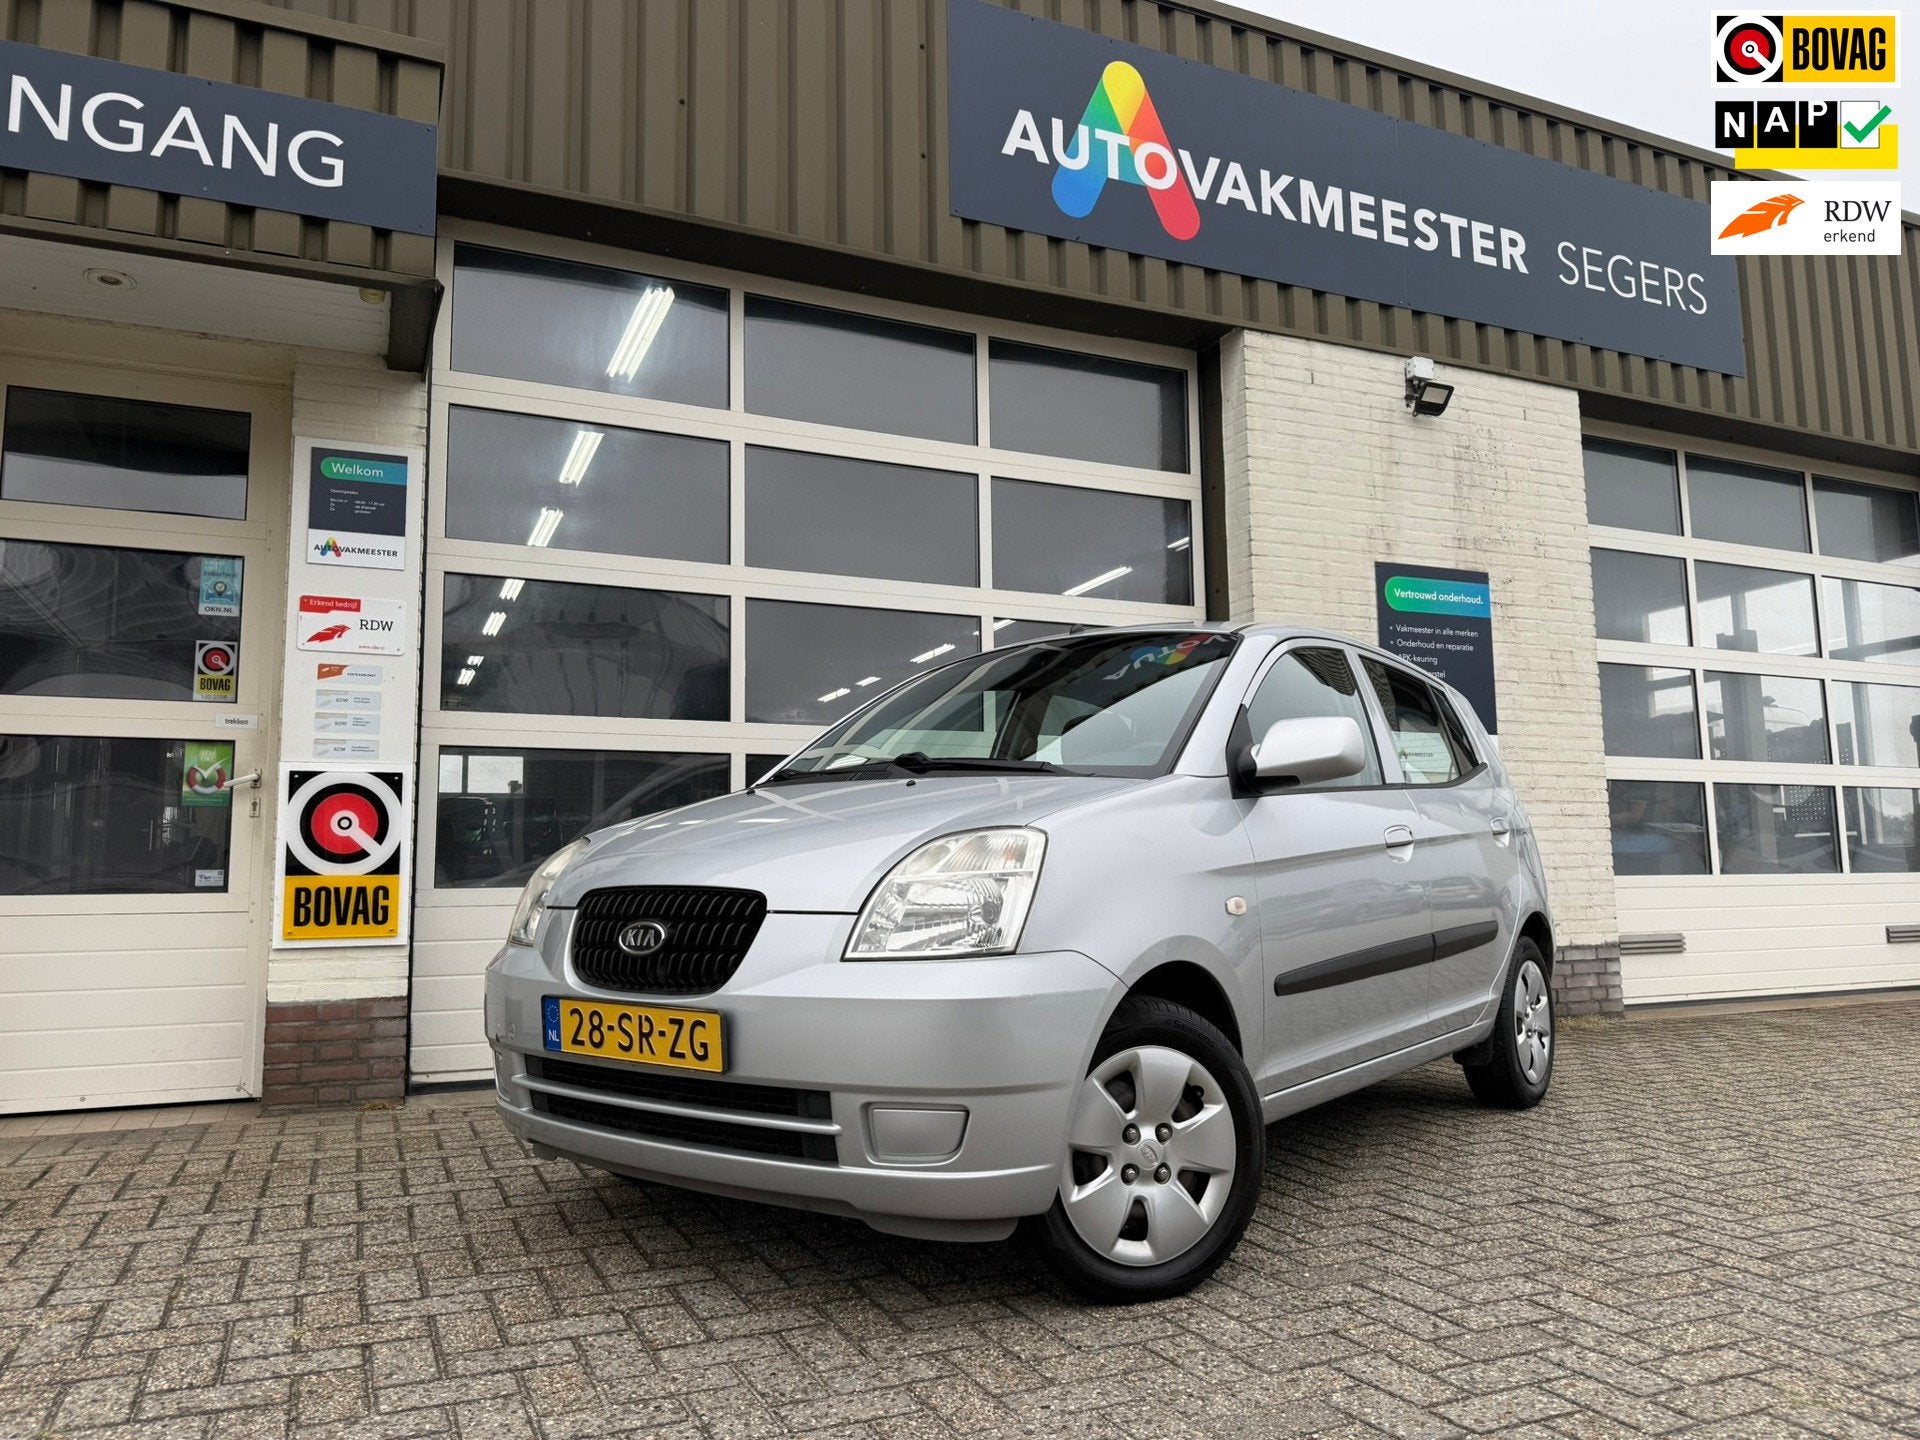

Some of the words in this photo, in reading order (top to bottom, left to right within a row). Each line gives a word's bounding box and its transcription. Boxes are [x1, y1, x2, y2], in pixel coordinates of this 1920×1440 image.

[8, 74, 344, 188] NGANG
[1001, 109, 1530, 275] AUTOVAKMEESTER
[1557, 241, 1708, 315] SEGERS
[331, 463, 384, 477] Welkom
[314, 544, 398, 557] AUTOVAKMEESTER
[1394, 588, 1437, 600] Vertrouwd
[1438, 591, 1484, 605] onderhoud.
[309, 599, 334, 607] Erkend
[335, 601, 358, 610] bedrijf
[359, 619, 394, 632] RDW
[1396, 624, 1434, 634] Vakmeester
[1442, 628, 1454, 636] alle
[1455, 629, 1479, 638] merken
[1396, 639, 1435, 649] Onderhoud
[1446, 643, 1474, 653] reparatie
[200, 677, 231, 691] BOVAG
[293, 885, 390, 927] BOVAG
[625, 928, 655, 946] KIA
[548, 1029, 560, 1042] NL
[569, 1007, 709, 1062] 28-SR-ZG
